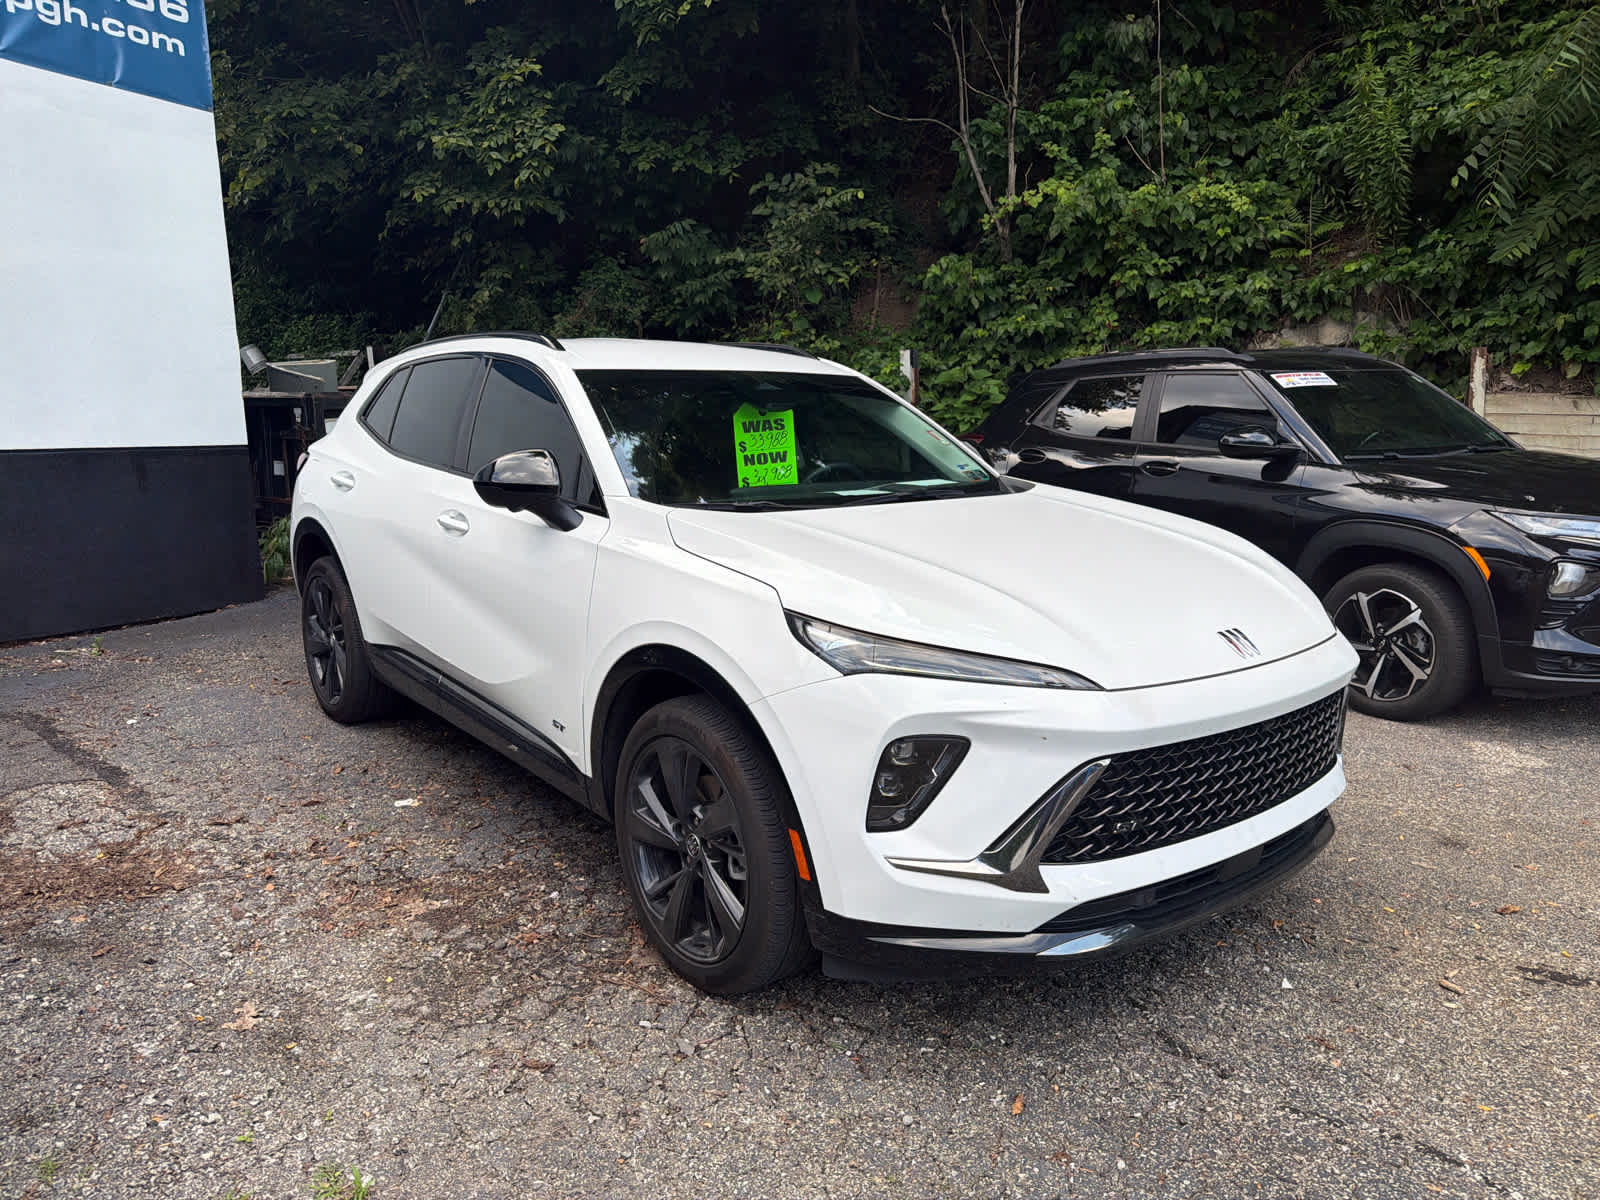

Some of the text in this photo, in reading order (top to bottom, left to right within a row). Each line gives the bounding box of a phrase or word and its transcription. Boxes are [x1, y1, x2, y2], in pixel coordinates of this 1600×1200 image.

[742, 418, 786, 433] WAS
[743, 450, 788, 466] NOW
[552, 719, 566, 732] ST
